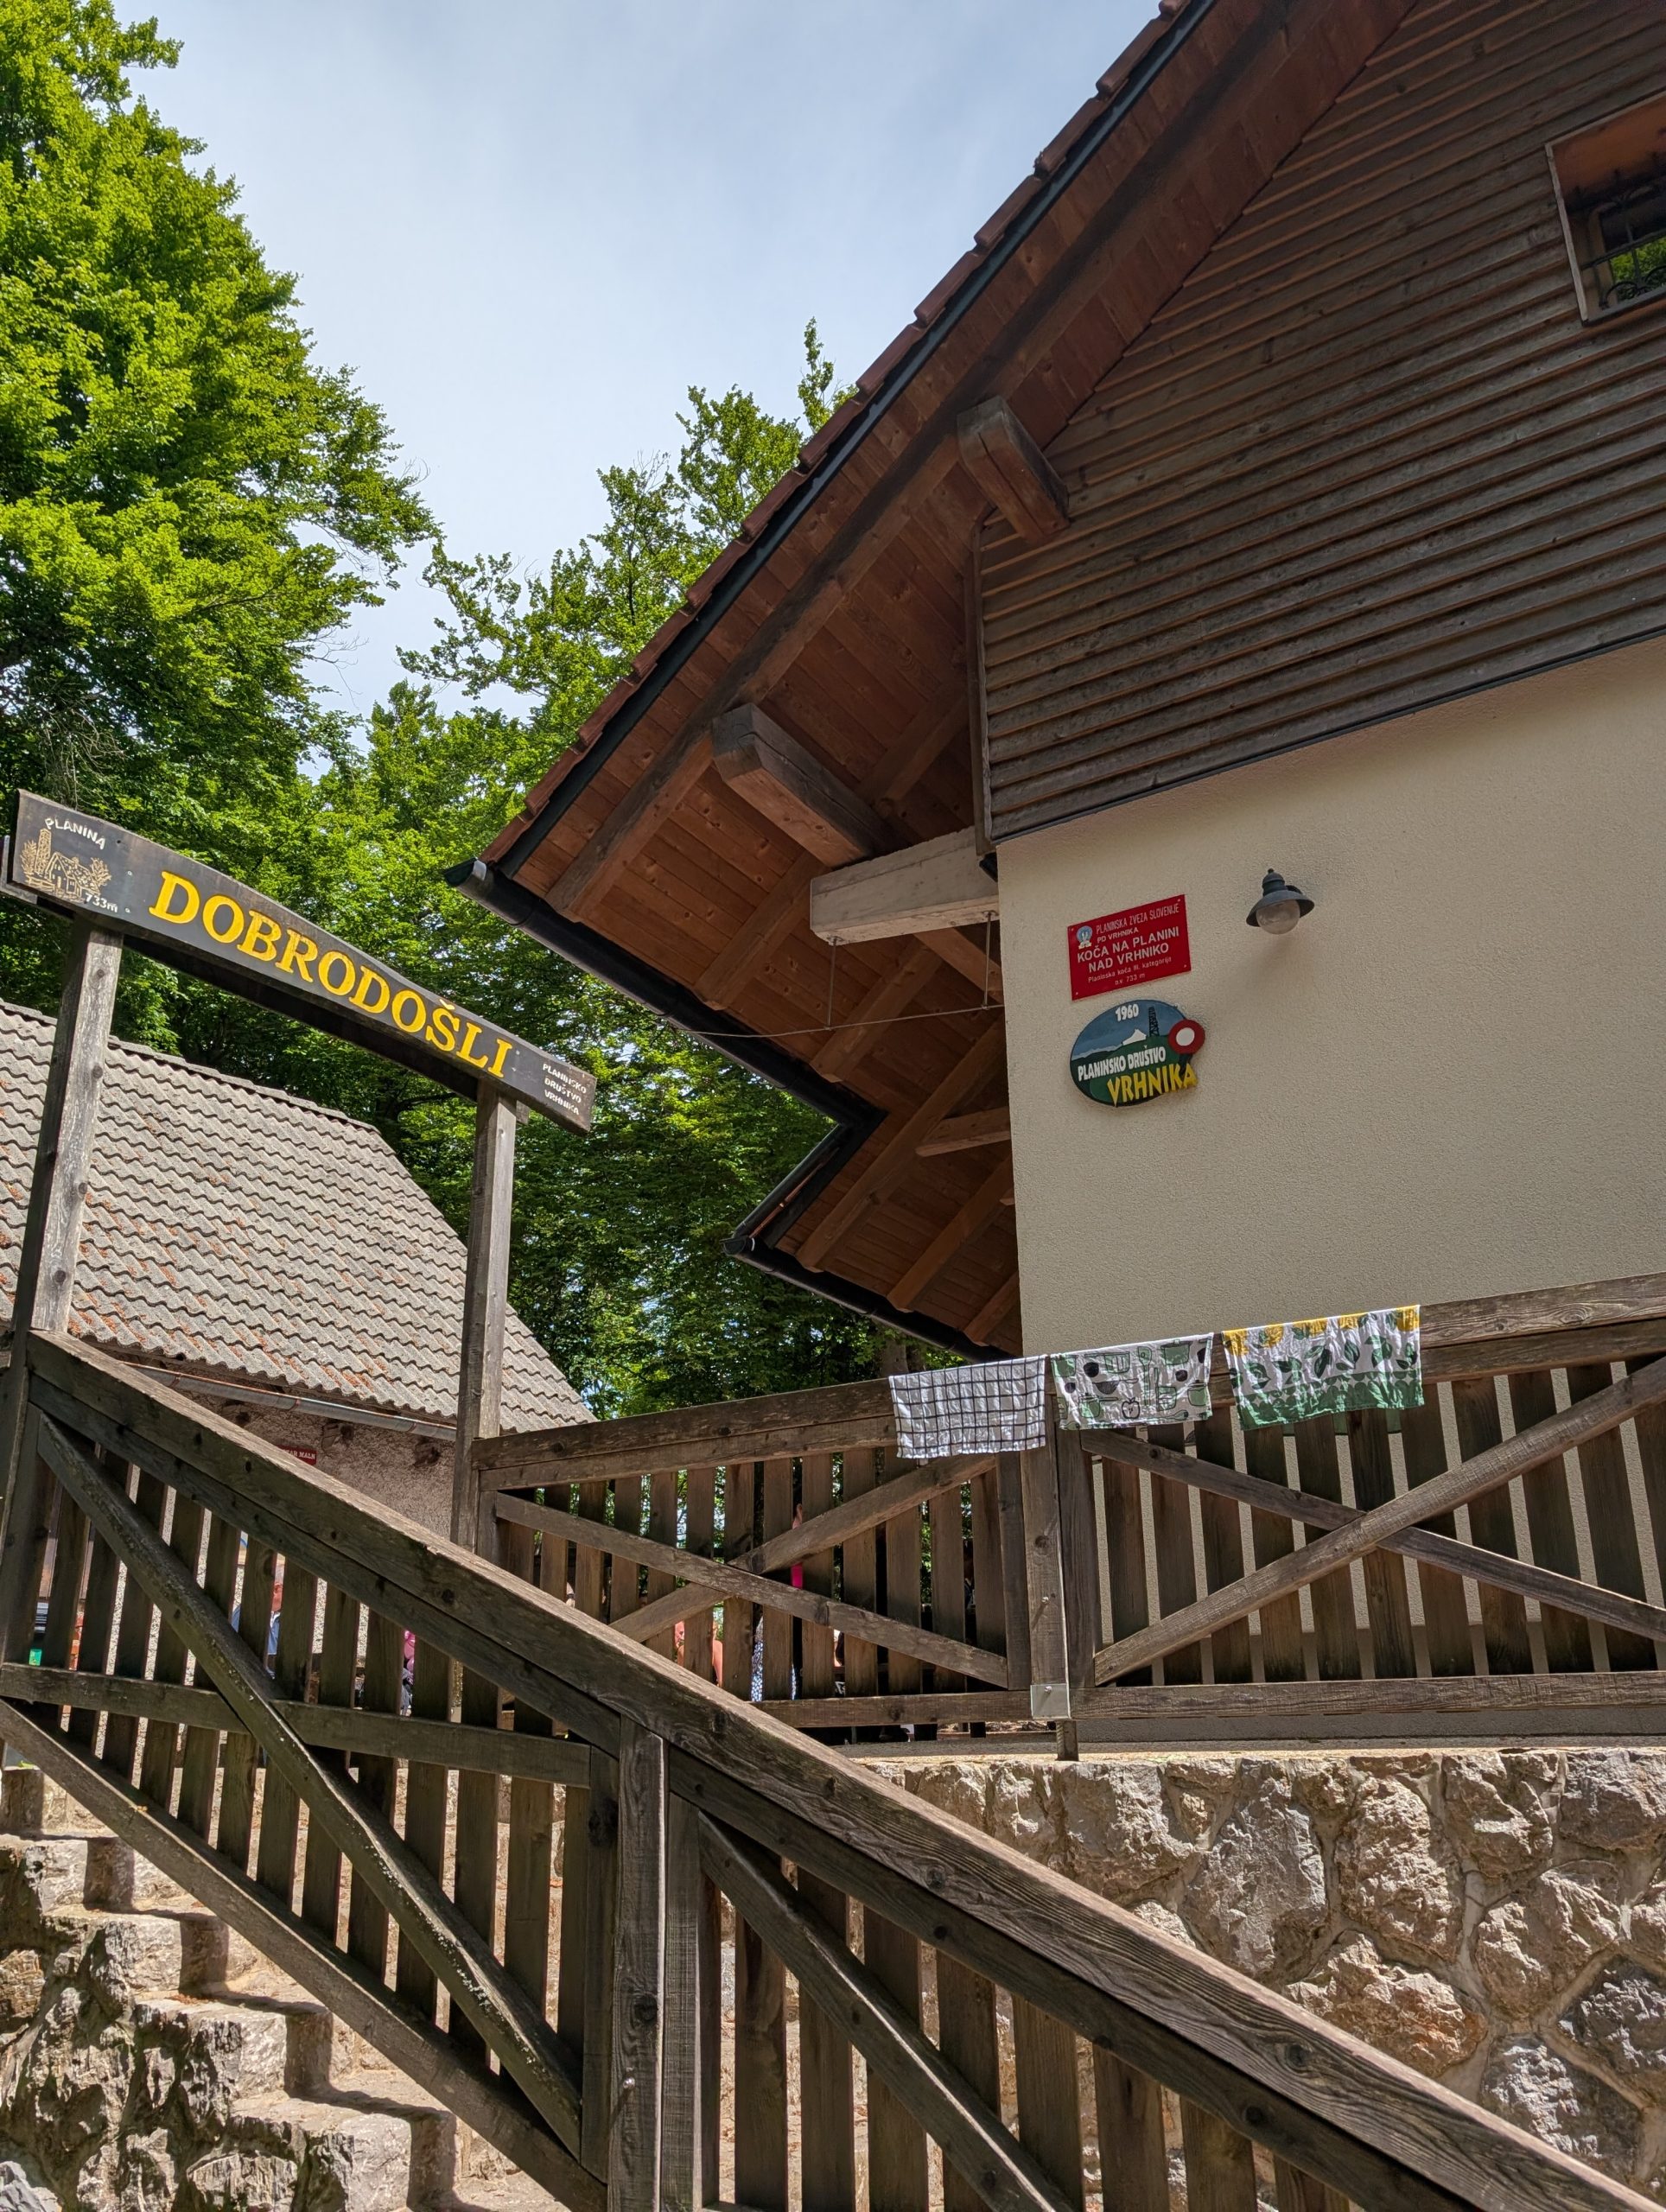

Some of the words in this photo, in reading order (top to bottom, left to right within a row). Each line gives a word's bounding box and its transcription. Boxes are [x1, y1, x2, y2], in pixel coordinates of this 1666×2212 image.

[44, 817, 106, 850] PLANINA
[85, 892, 118, 913] 733m
[1096, 918, 1128, 935] PLANINSKA
[1129, 912, 1148, 926] ZVEZA
[1149, 903, 1180, 920] SLOVENIJE
[1077, 945, 1110, 963] KOČA
[1112, 940, 1129, 954] NA
[1133, 926, 1180, 947] PLANINI
[1097, 935, 1107, 944] PD
[1108, 926, 1139, 942] VRHNIKA
[1088, 957, 1114, 973] NAD
[1117, 942, 1169, 965] VRHNIKO
[1088, 971, 1116, 983] Planinska
[1117, 966, 1131, 976] koča
[1142, 956, 1172, 969] kategorija
[149, 870, 512, 1078] DOBRODOŠLI
[1126, 974, 1138, 982] 733
[1115, 1002, 1139, 1022] 1960
[543, 1063, 587, 1094] PLANINSKO
[1078, 1051, 1127, 1082] PLANINSKO
[1127, 1044, 1167, 1068] DRUŠTVO
[544, 1077, 582, 1103] DRUŠTVO
[1106, 1061, 1199, 1107] VRHNIKA
[544, 1089, 580, 1116] VRHNIKA
